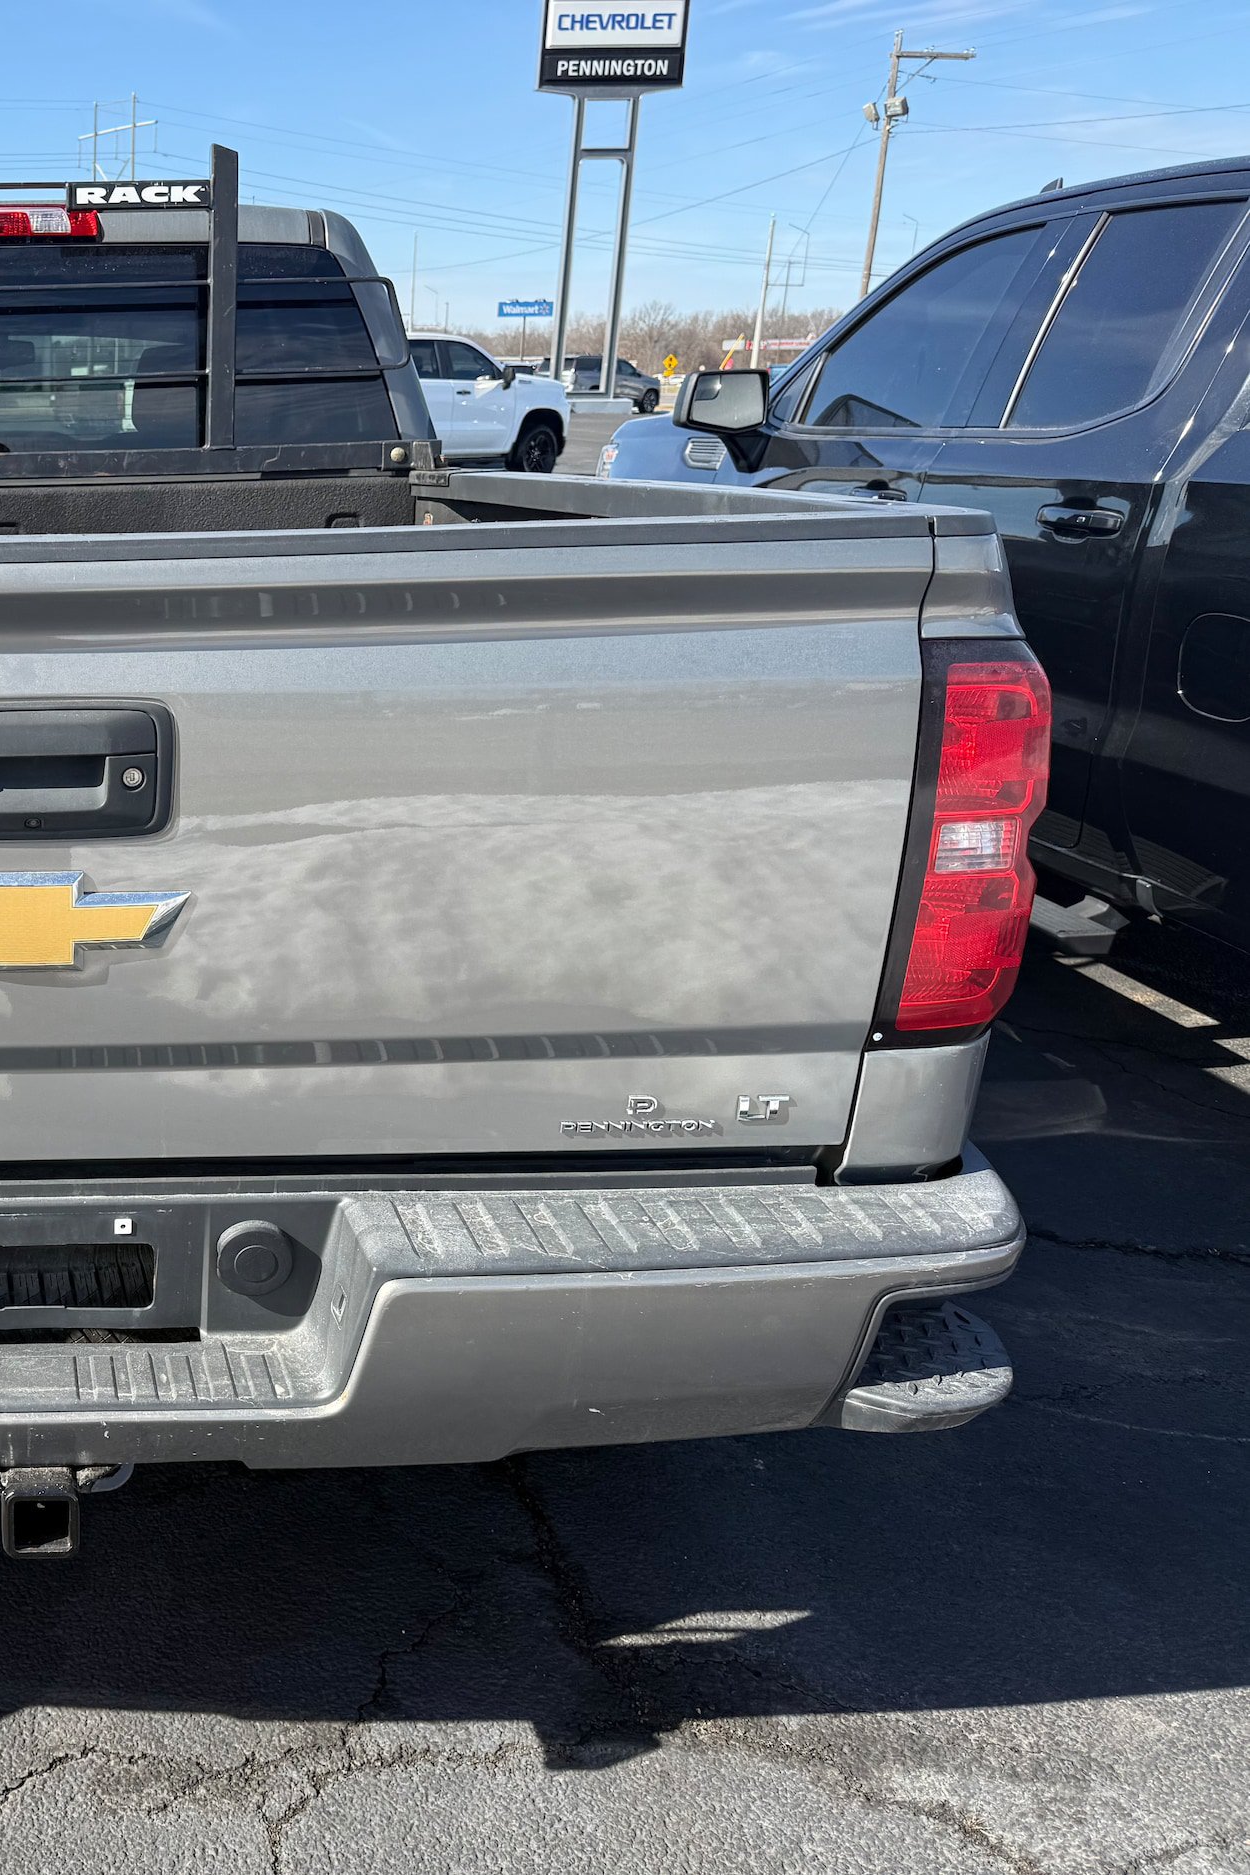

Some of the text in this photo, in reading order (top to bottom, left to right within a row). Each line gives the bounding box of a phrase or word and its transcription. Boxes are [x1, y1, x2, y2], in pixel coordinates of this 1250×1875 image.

[558, 13, 676, 30] CHEVROLET
[557, 59, 668, 76] PENNINGTON
[76, 185, 202, 204] RACK
[502, 304, 538, 314] Walmart
[736, 1094, 789, 1121] LT
[560, 1119, 715, 1134] PENNINGTON
